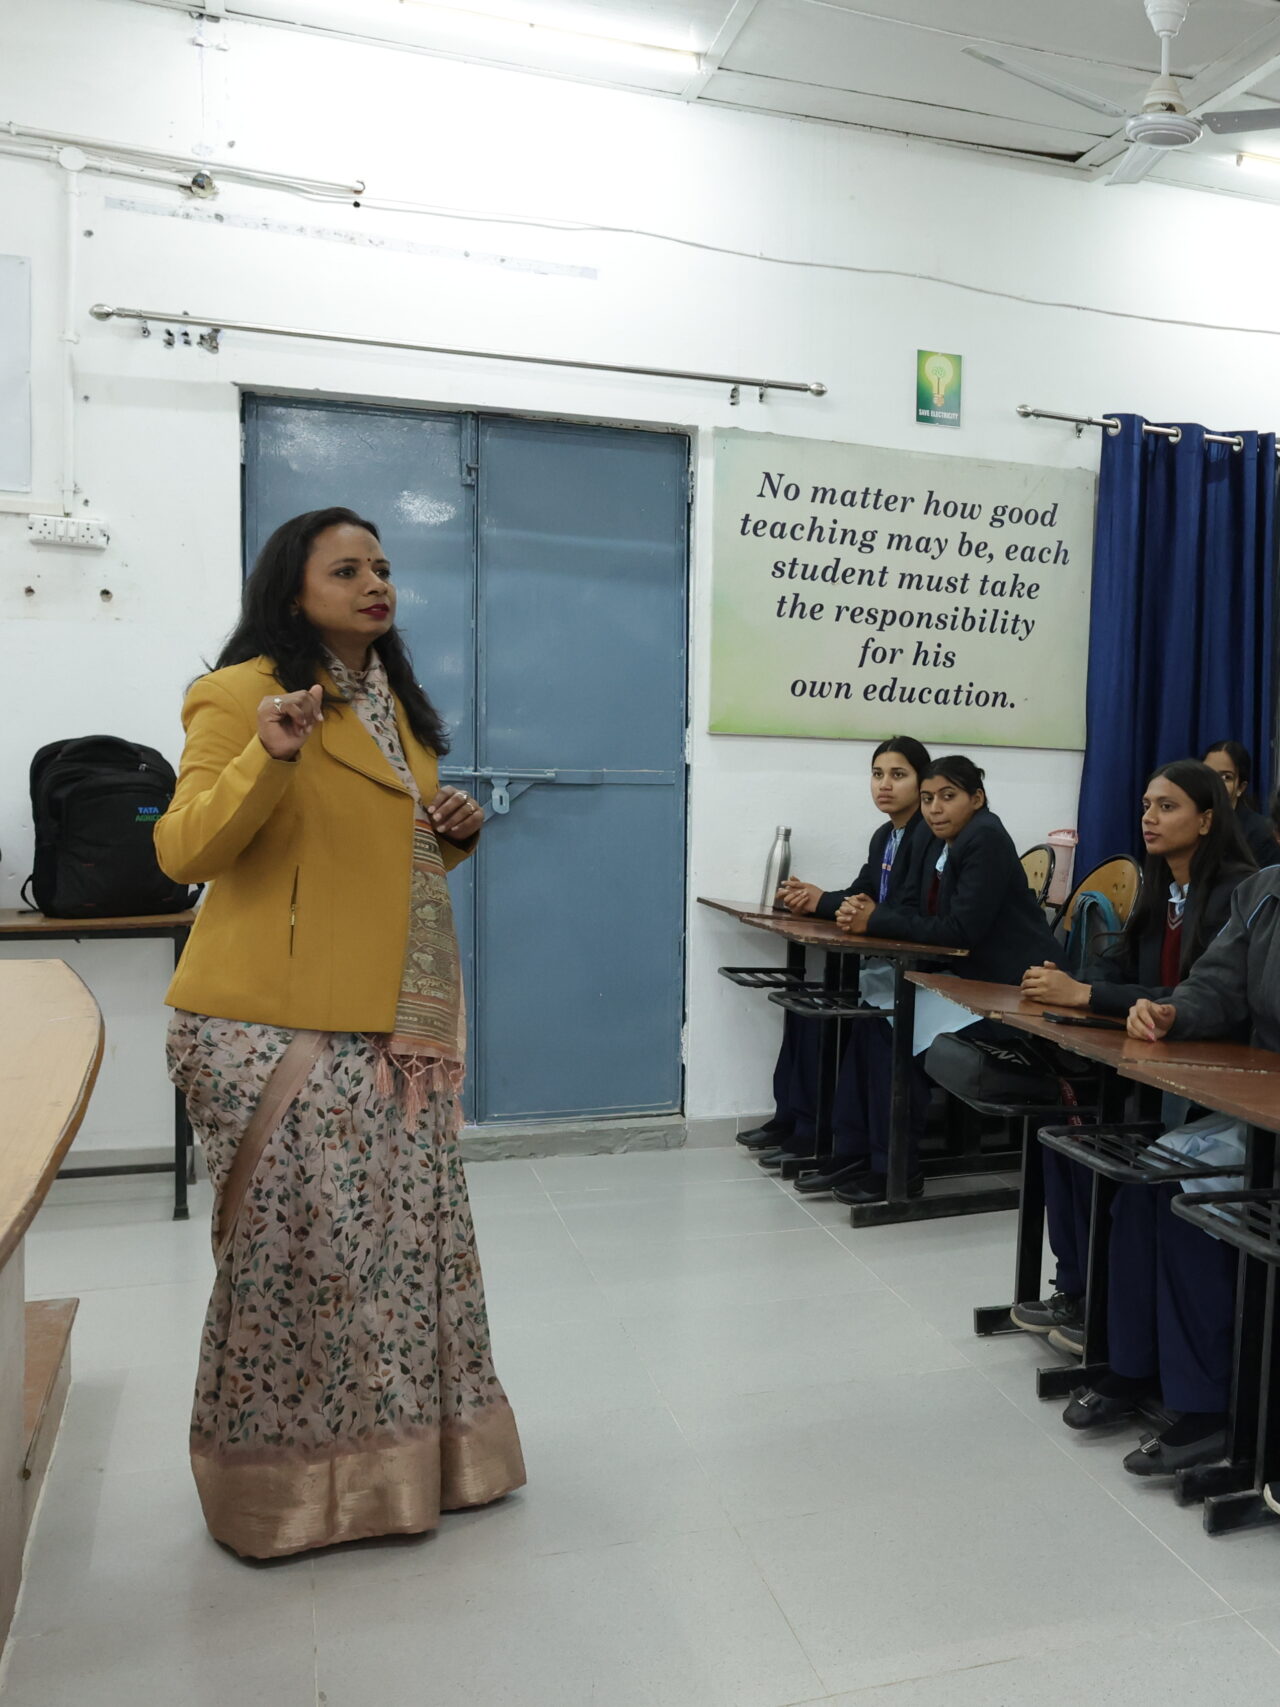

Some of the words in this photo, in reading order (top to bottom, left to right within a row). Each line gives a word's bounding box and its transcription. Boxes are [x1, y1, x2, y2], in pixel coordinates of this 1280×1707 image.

[931, 410, 958, 419] ELECTRICITY
[757, 471, 801, 502] No
[810, 485, 916, 513] matter
[923, 489, 983, 521] how
[988, 502, 1059, 529] good
[740, 513, 879, 555] teaching
[886, 532, 949, 561] may
[957, 531, 995, 564] be,
[1004, 539, 1071, 566] each
[770, 557, 889, 588] student
[897, 572, 971, 595] must
[979, 572, 1041, 600] take
[776, 592, 825, 621] the
[834, 604, 1036, 642] responsibility
[857, 636, 904, 669] for
[911, 640, 957, 669] his
[790, 679, 853, 700] own
[862, 676, 1016, 709] education.
